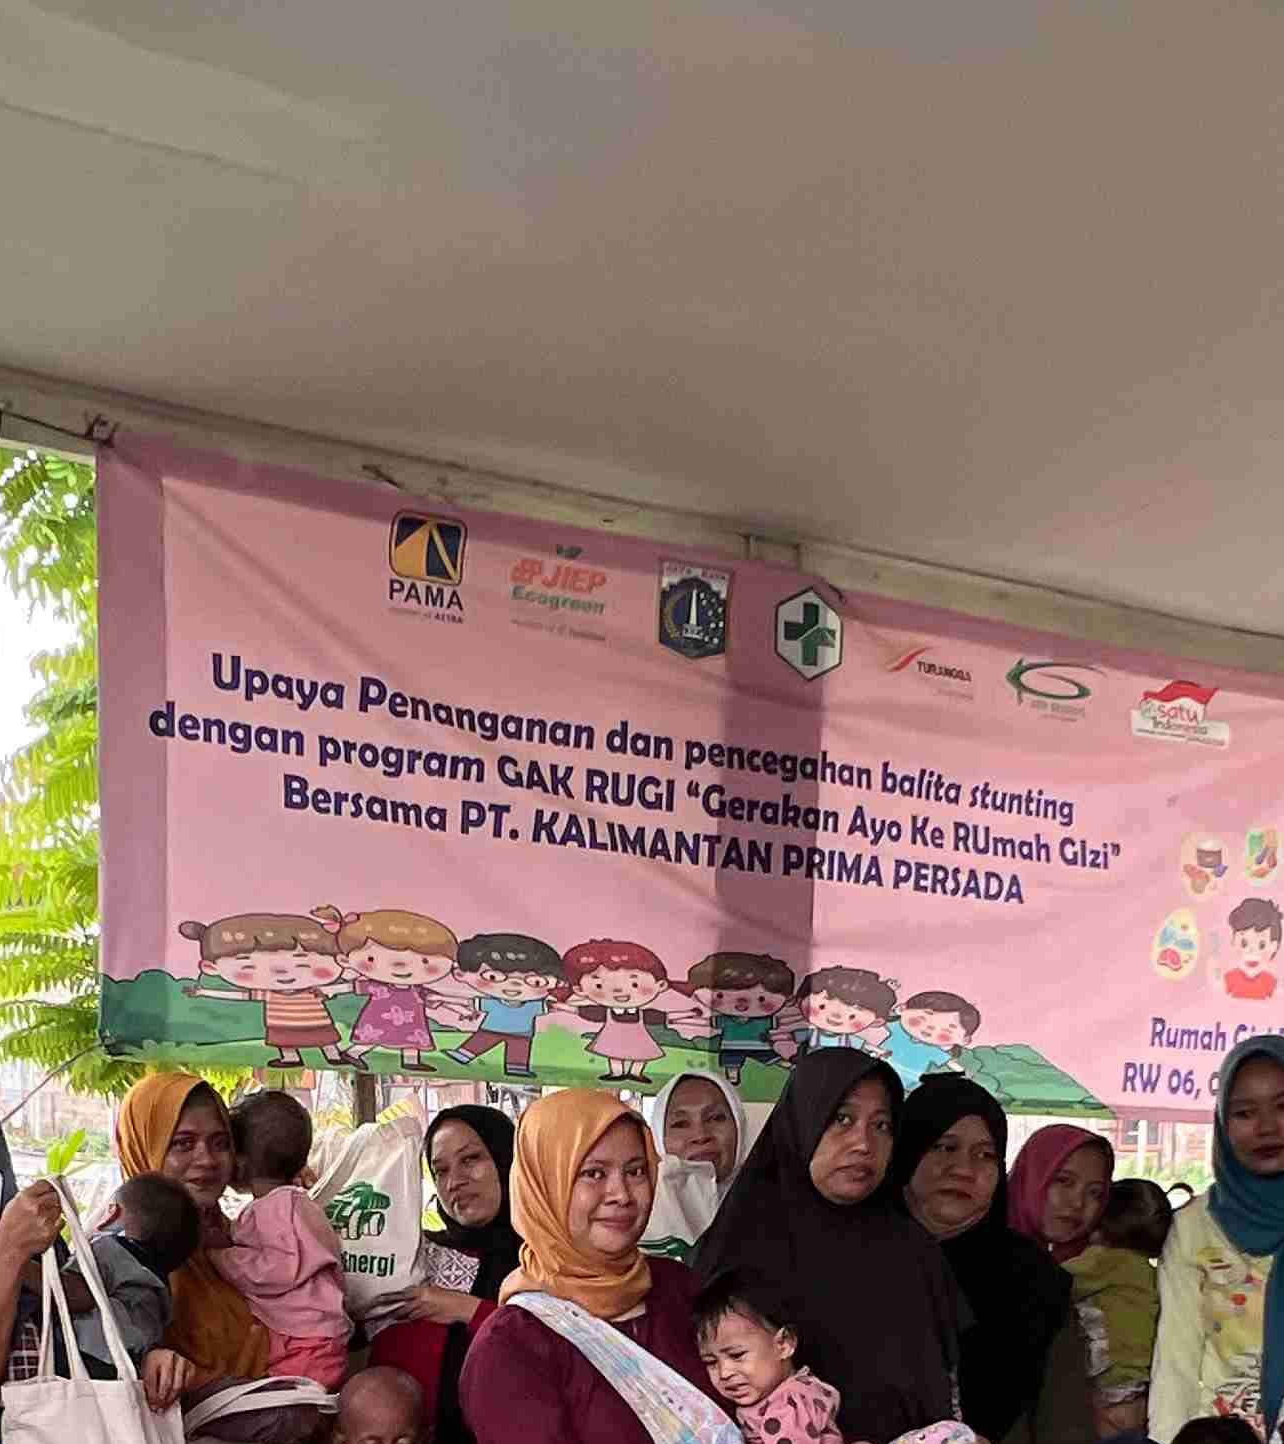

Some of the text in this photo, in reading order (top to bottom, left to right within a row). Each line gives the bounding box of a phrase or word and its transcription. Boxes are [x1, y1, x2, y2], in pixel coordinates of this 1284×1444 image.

[388, 578, 464, 611] PAMA
[148, 700, 305, 757] dengan
[317, 735, 485, 783] program
[497, 754, 575, 800] GAK
[585, 768, 676, 813] RUGI
[847, 805, 902, 846] Ayo
[910, 815, 945, 849] Ke
[952, 821, 1051, 864] RUmah
[212, 652, 1074, 827] Upaya Penanganan dan pencegahan balita stunting
[283, 772, 1025, 905] Bersama PT. KALIMANTAN PRIMA PERSADA
[1150, 1016, 1226, 1052] Rumah
[1121, 1061, 1161, 1094] RW
[1167, 1069, 1202, 1100] 06,
